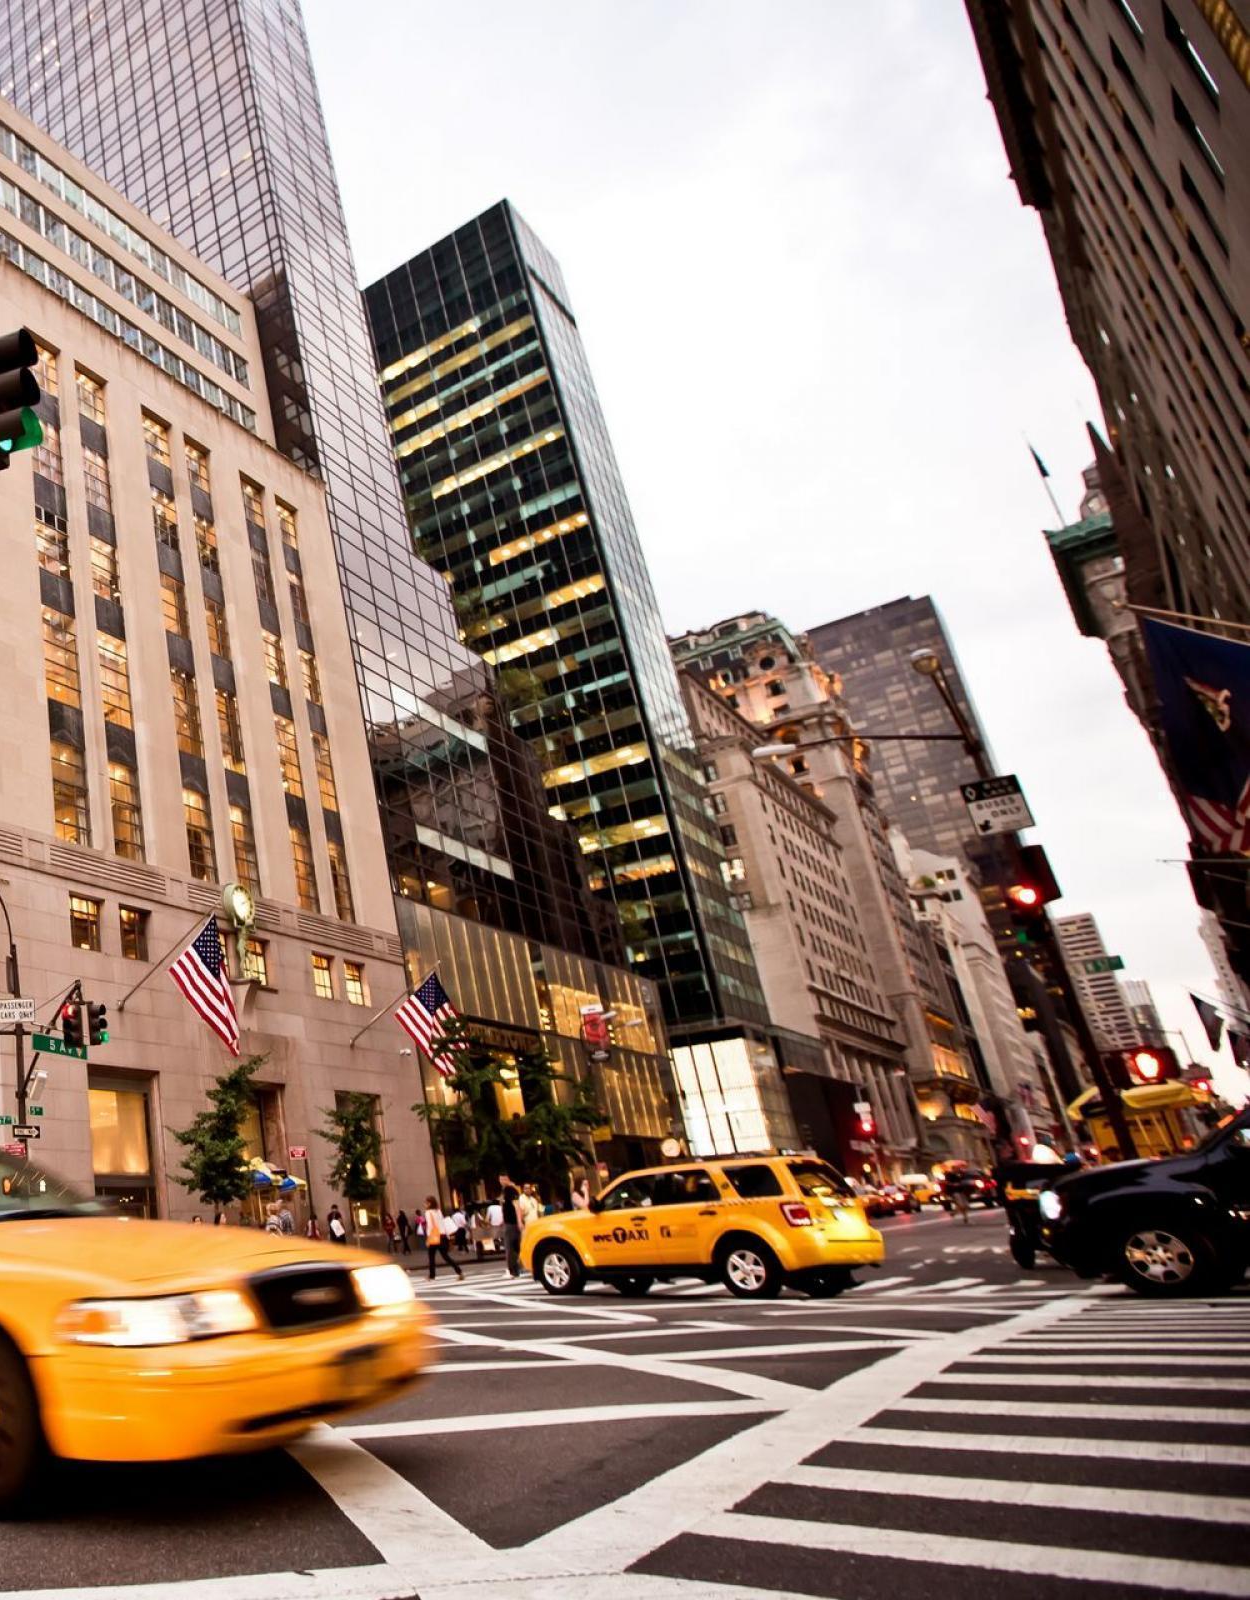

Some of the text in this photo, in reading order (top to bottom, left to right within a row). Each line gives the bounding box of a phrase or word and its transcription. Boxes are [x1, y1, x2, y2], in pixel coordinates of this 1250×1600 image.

[976, 796, 1016, 811] BUSES
[990, 806, 1022, 818] ONLY
[0, 1002, 33, 1010] PASSENGER
[0, 1011, 33, 1019] CARS ONLY
[49, 1039, 56, 1051] 5
[612, 1227, 649, 1244] TAXI
